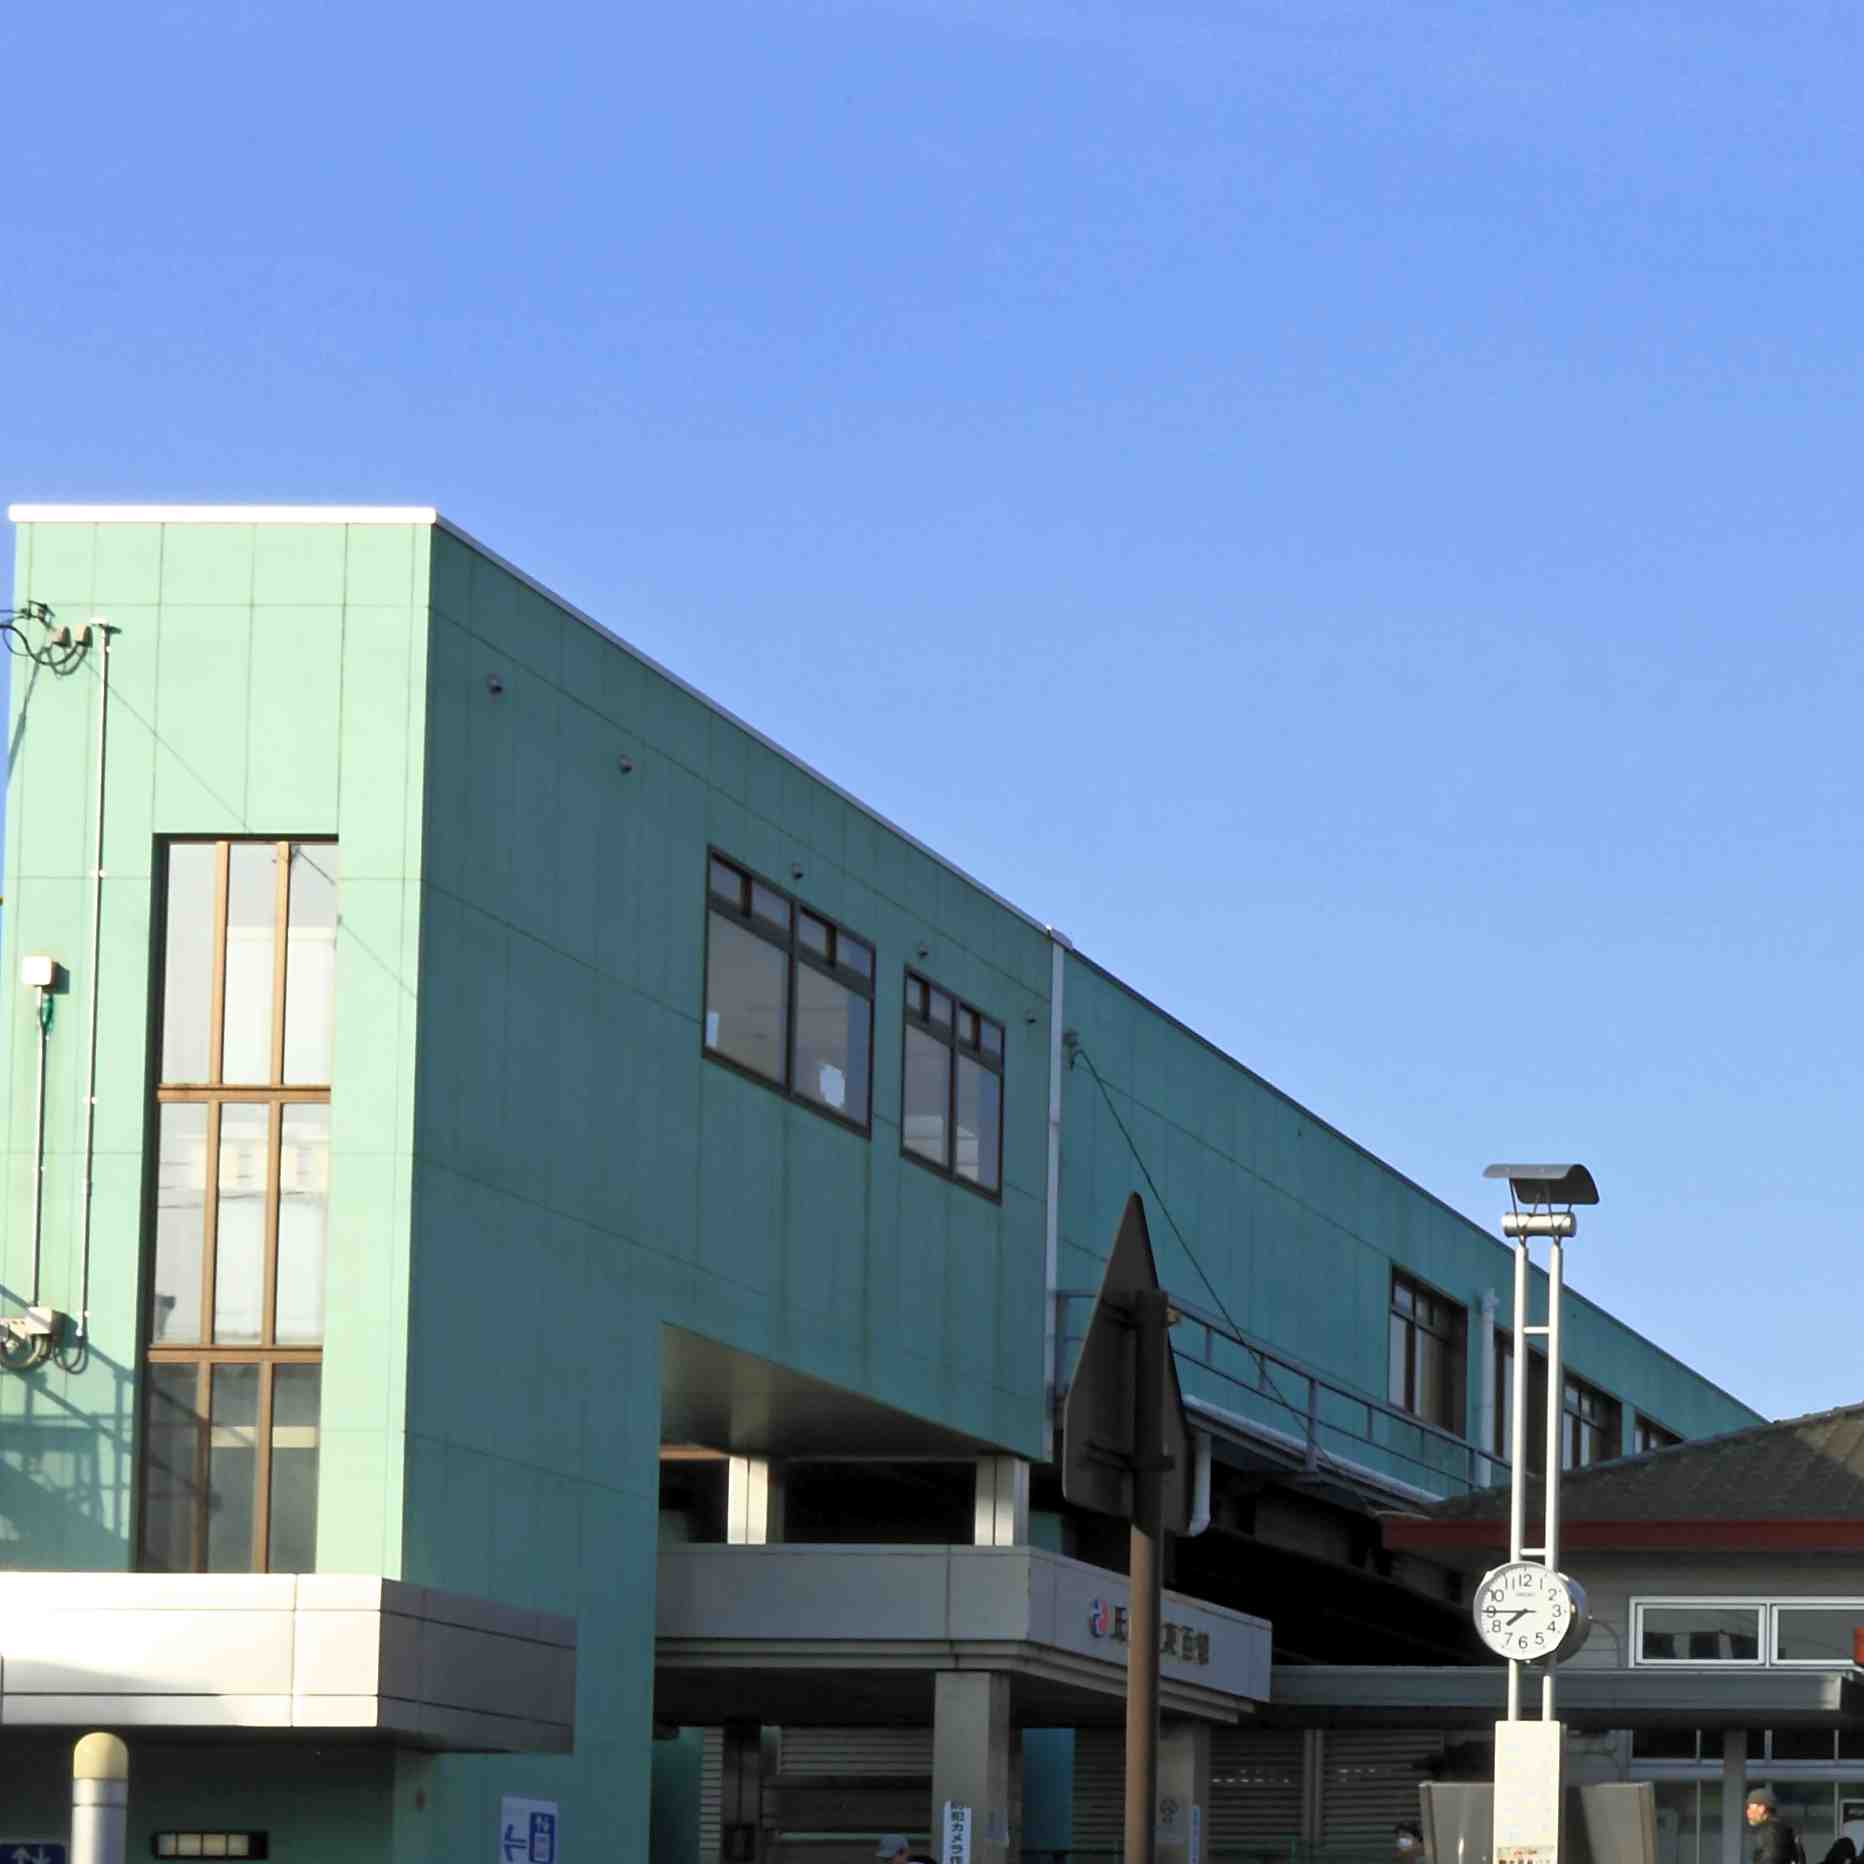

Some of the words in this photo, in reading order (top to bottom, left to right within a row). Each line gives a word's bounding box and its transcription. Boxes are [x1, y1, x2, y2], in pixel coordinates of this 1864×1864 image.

[1519, 1573, 1532, 1587] 12
[1490, 1589, 1504, 1602] 10
[1547, 1588, 1557, 1600] 2
[1486, 1605, 1497, 1618] 9
[1552, 1604, 1561, 1617] 3
[1492, 1620, 1502, 1632] 8
[1546, 1621, 1556, 1632] 4
[1504, 1632, 1513, 1645] 7
[1518, 1635, 1528, 1649] 6
[1535, 1632, 1545, 1645] 5
